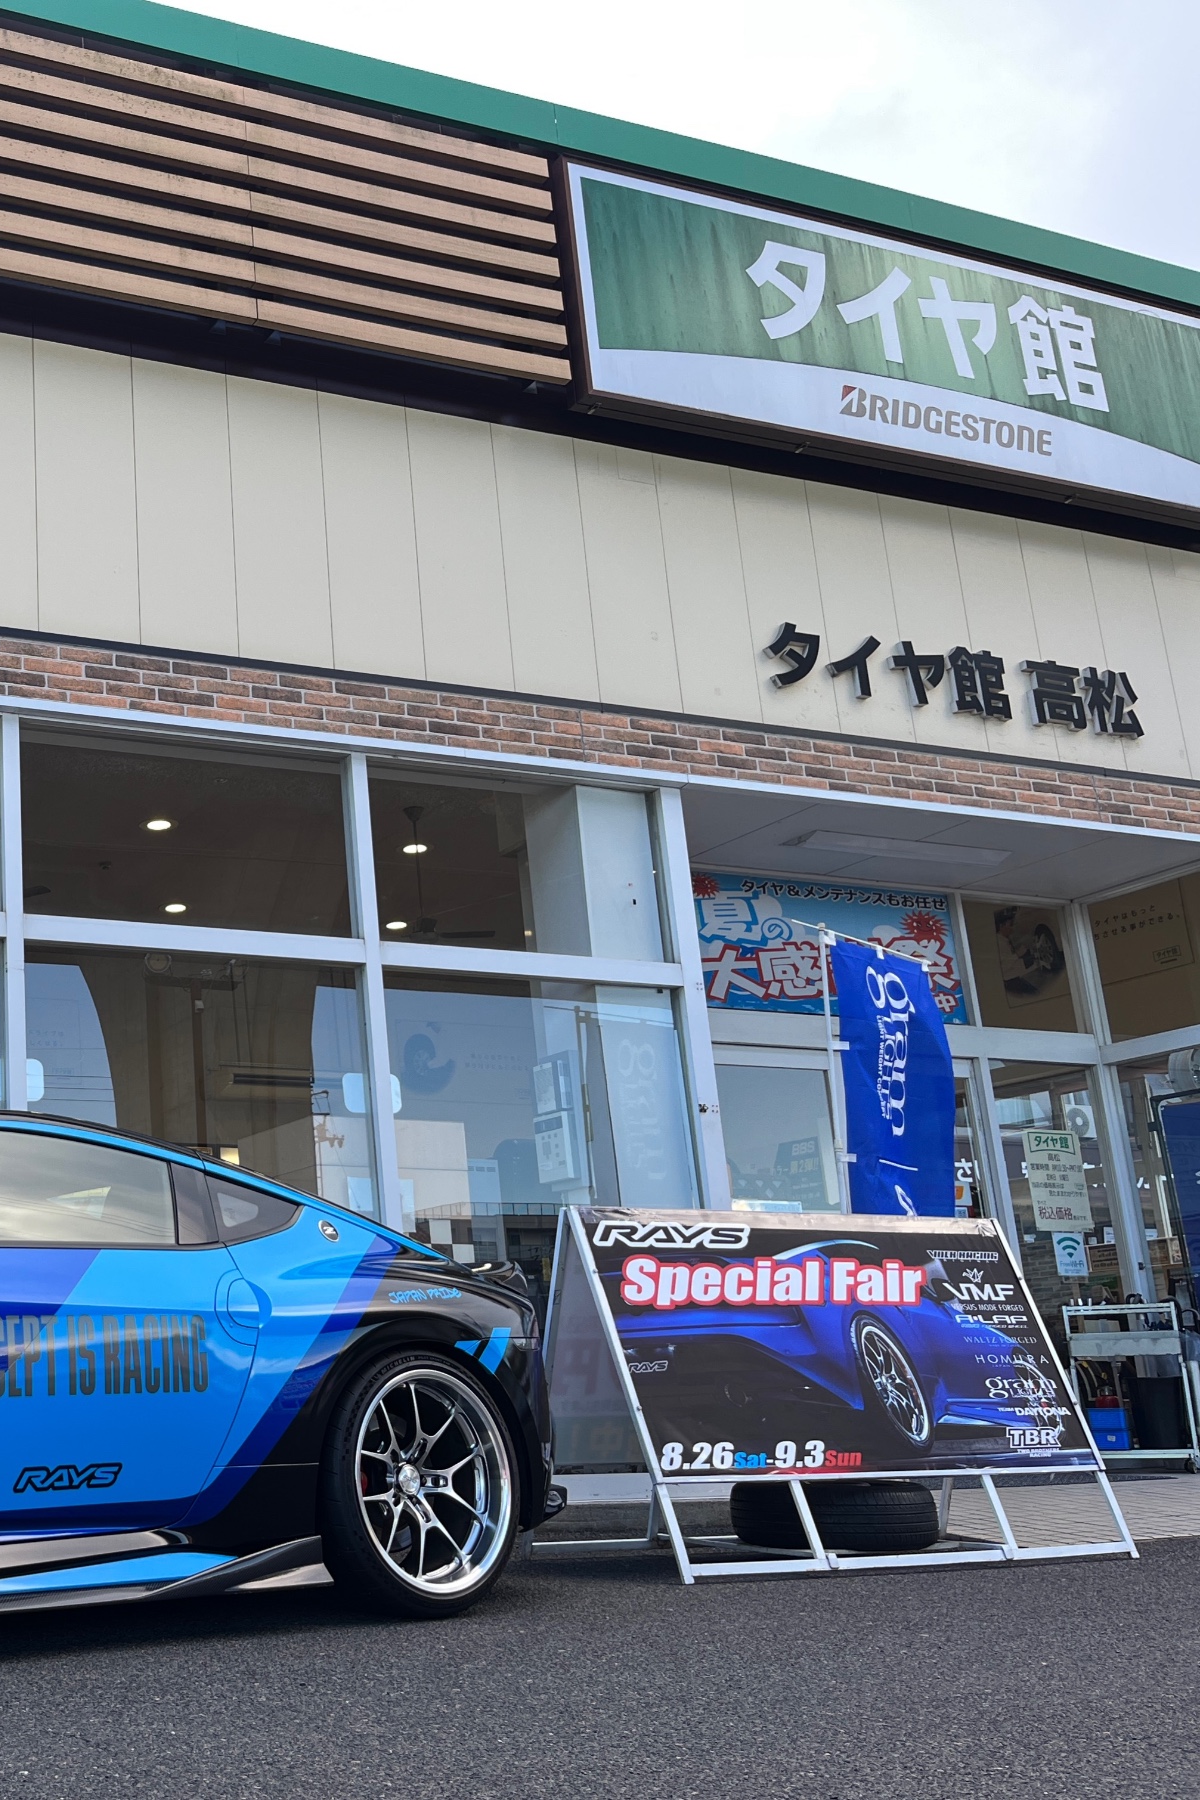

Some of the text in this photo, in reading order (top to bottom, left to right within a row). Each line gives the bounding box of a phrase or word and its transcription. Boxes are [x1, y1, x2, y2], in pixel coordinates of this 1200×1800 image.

[745, 239, 1110, 413] タイヤ館
[839, 384, 1053, 456] BRIDGESTONE
[763, 621, 1145, 739] タイヤ館 高松
[700, 890, 793, 942] 夏の
[865, 965, 916, 1137] gram
[1034, 1136, 1070, 1149] タイヤ館
[1038, 1206, 1073, 1221] 税込価格
[593, 1220, 750, 1249] RAYS
[622, 1256, 924, 1308] Special Fair
[942, 1282, 1015, 1301] VMF
[389, 1288, 428, 1304] JAPAN
[963, 1336, 998, 1344] WALTZ
[66, 1314, 96, 1397] IS
[102, 1314, 209, 1396] RACING
[629, 1359, 669, 1374] RAYS
[974, 1354, 1050, 1364] HOMURA
[1015, 1407, 1071, 1416] DAYTONA
[1007, 1427, 1060, 1448] TBR
[13, 1462, 123, 1493] RAYS
